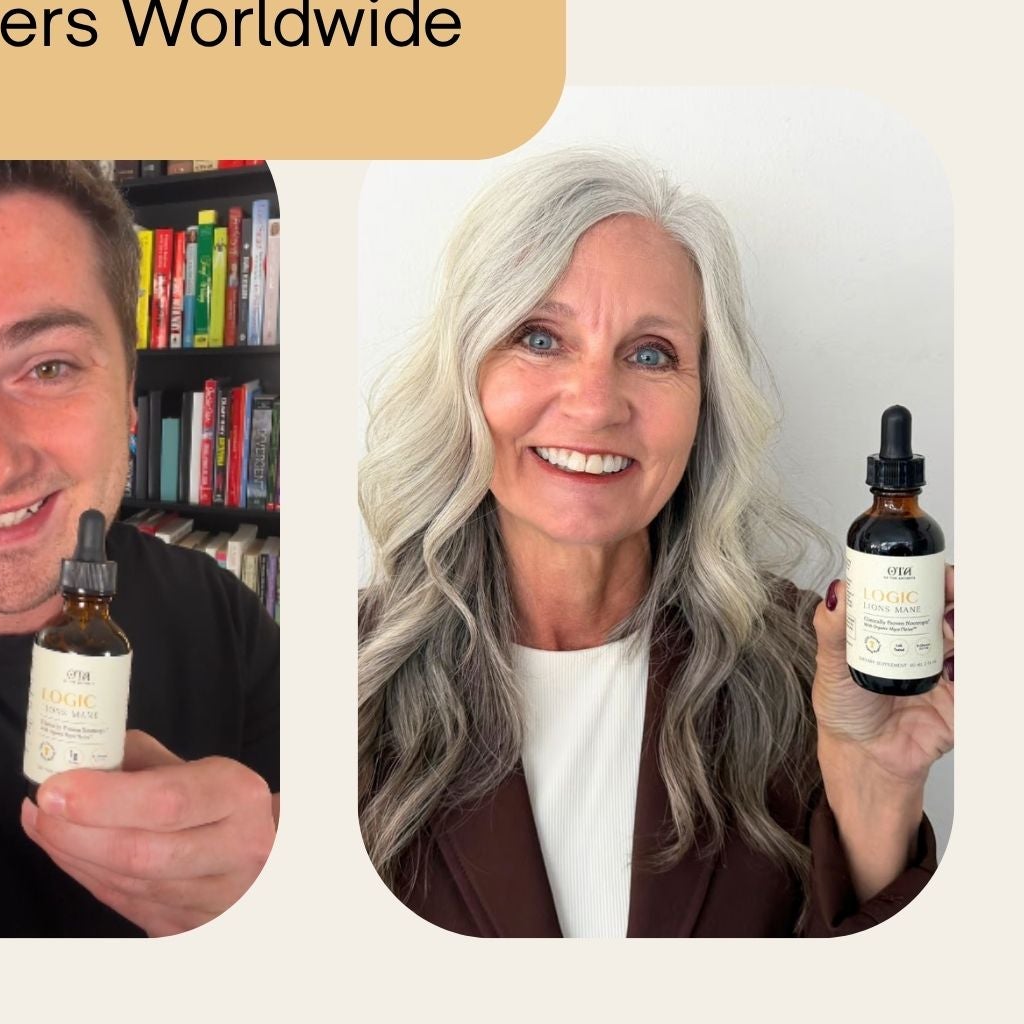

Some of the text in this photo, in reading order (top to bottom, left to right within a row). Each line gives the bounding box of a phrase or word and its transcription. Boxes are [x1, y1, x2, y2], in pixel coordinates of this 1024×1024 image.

[863, 587, 918, 604] LOGIC
[863, 601, 921, 613] LIONS MANE
[41, 687, 96, 709] LOGIC
